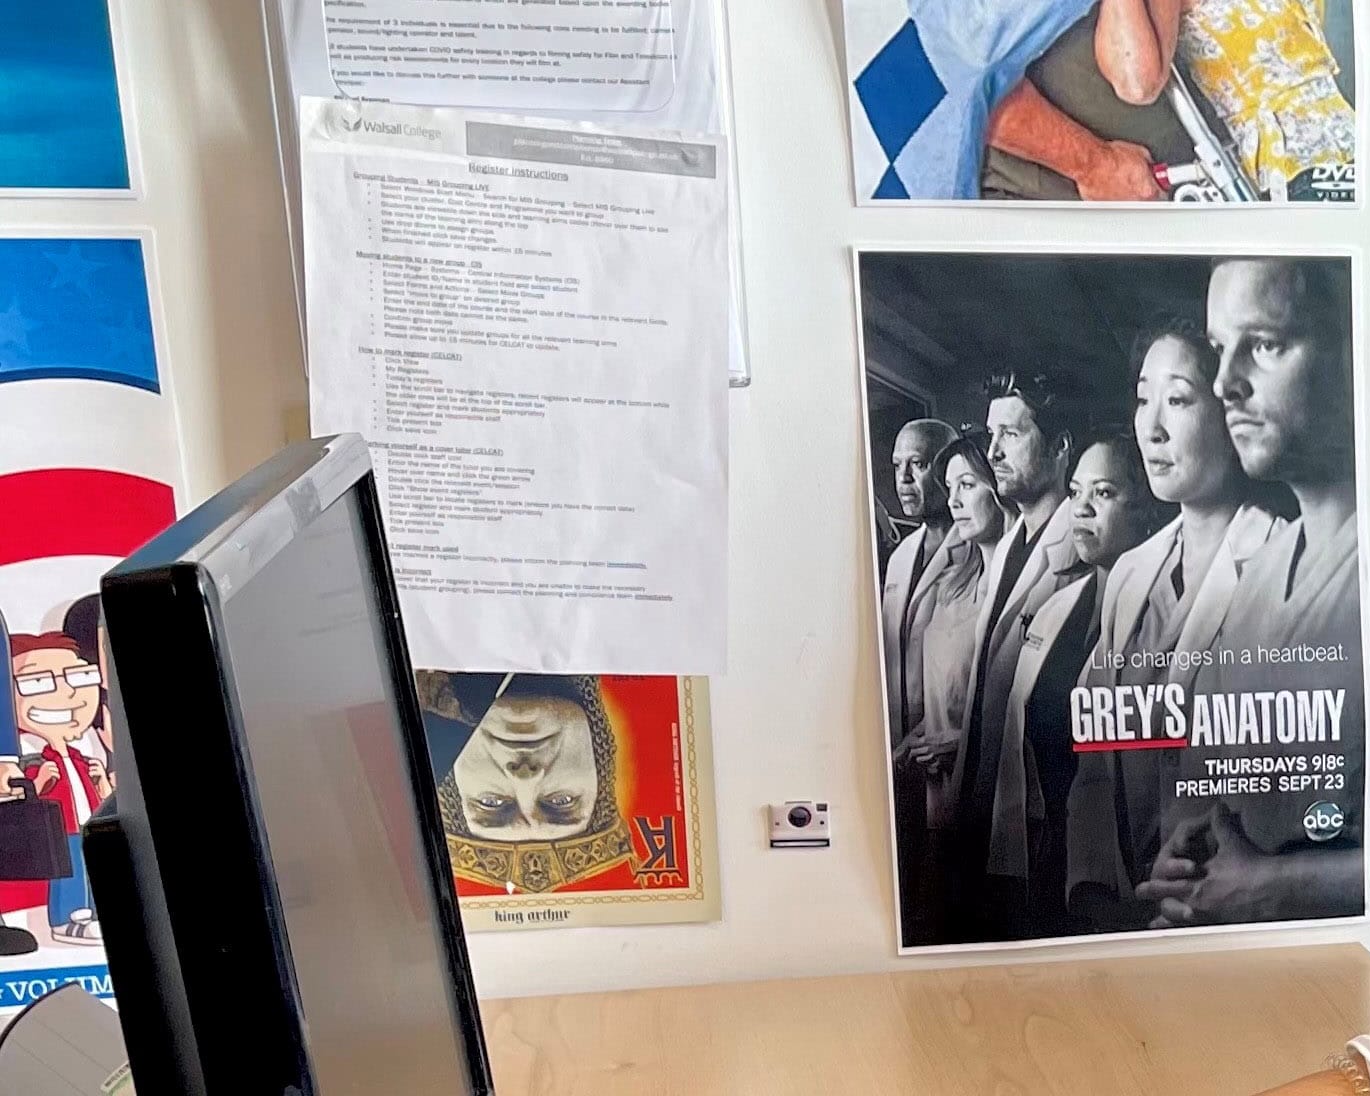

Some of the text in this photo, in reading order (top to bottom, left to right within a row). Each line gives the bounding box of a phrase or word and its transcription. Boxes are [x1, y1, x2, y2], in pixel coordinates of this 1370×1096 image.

[364, 121, 402, 136] Walsall
[469, 162, 568, 180] Register Instructions
[1091, 643, 1349, 671] Life changes in a heartbeat.
[1070, 683, 1346, 747] GREY'S ANATOMY
[1205, 756, 1307, 776] THURSDAYS
[1176, 774, 1344, 797] PREMIERES SEPT 23
[1303, 810, 1344, 828] abc
[495, 908, 570, 923] king arthur
